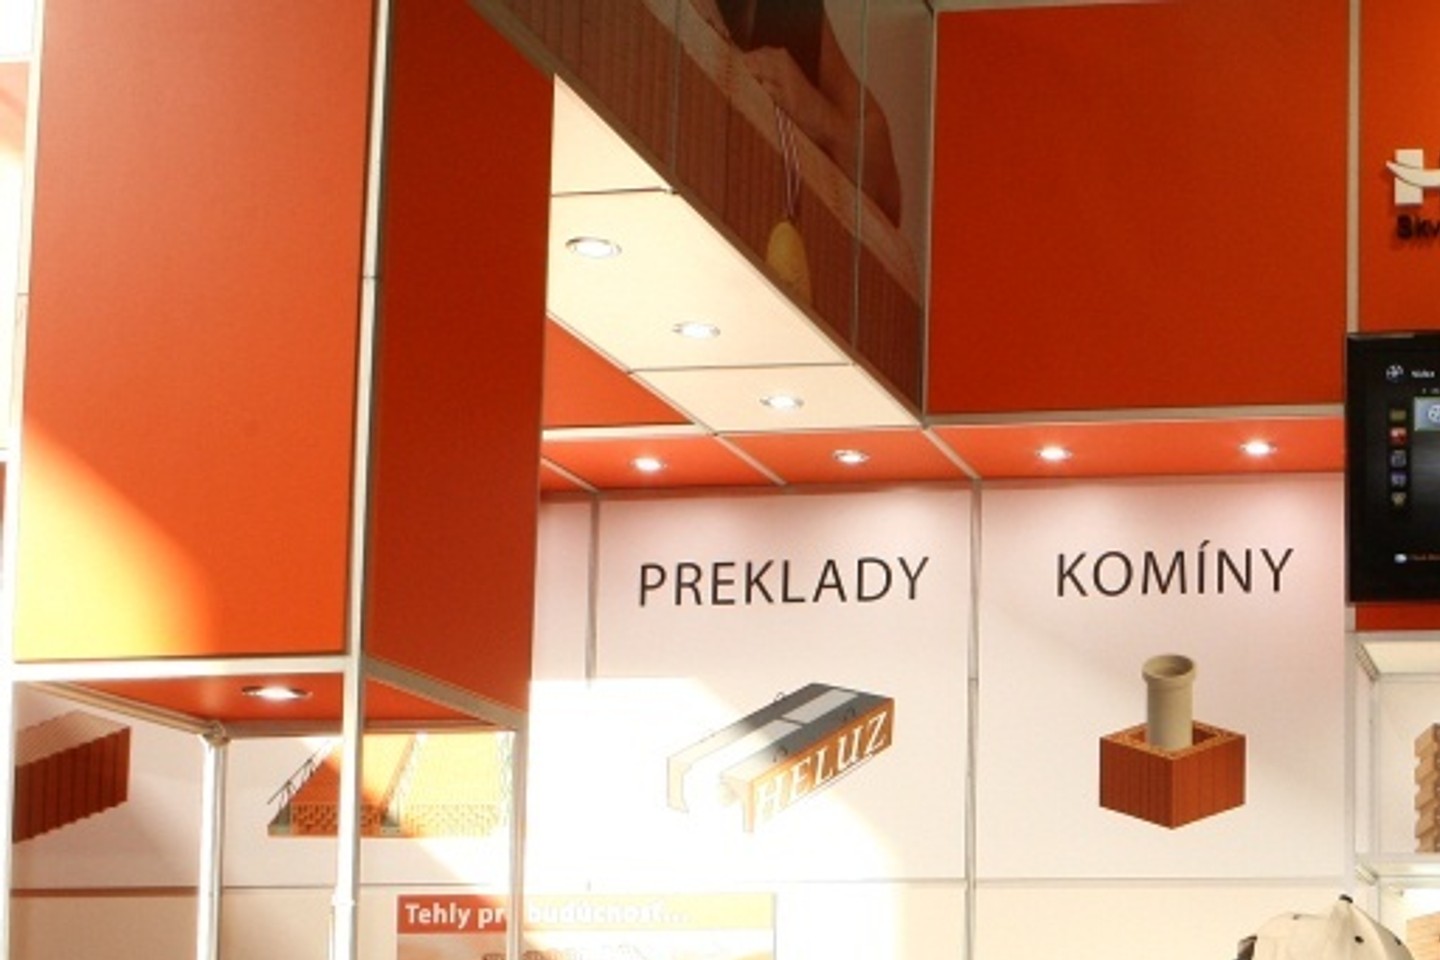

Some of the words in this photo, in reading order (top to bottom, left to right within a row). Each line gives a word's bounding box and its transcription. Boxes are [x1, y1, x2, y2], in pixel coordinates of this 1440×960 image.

[639, 556, 929, 607] PREKLADY
[1055, 540, 1295, 598] KOMÍNY
[754, 711, 888, 820] HELUZ
[405, 903, 471, 929] Tehly
[478, 906, 508, 929] pr
